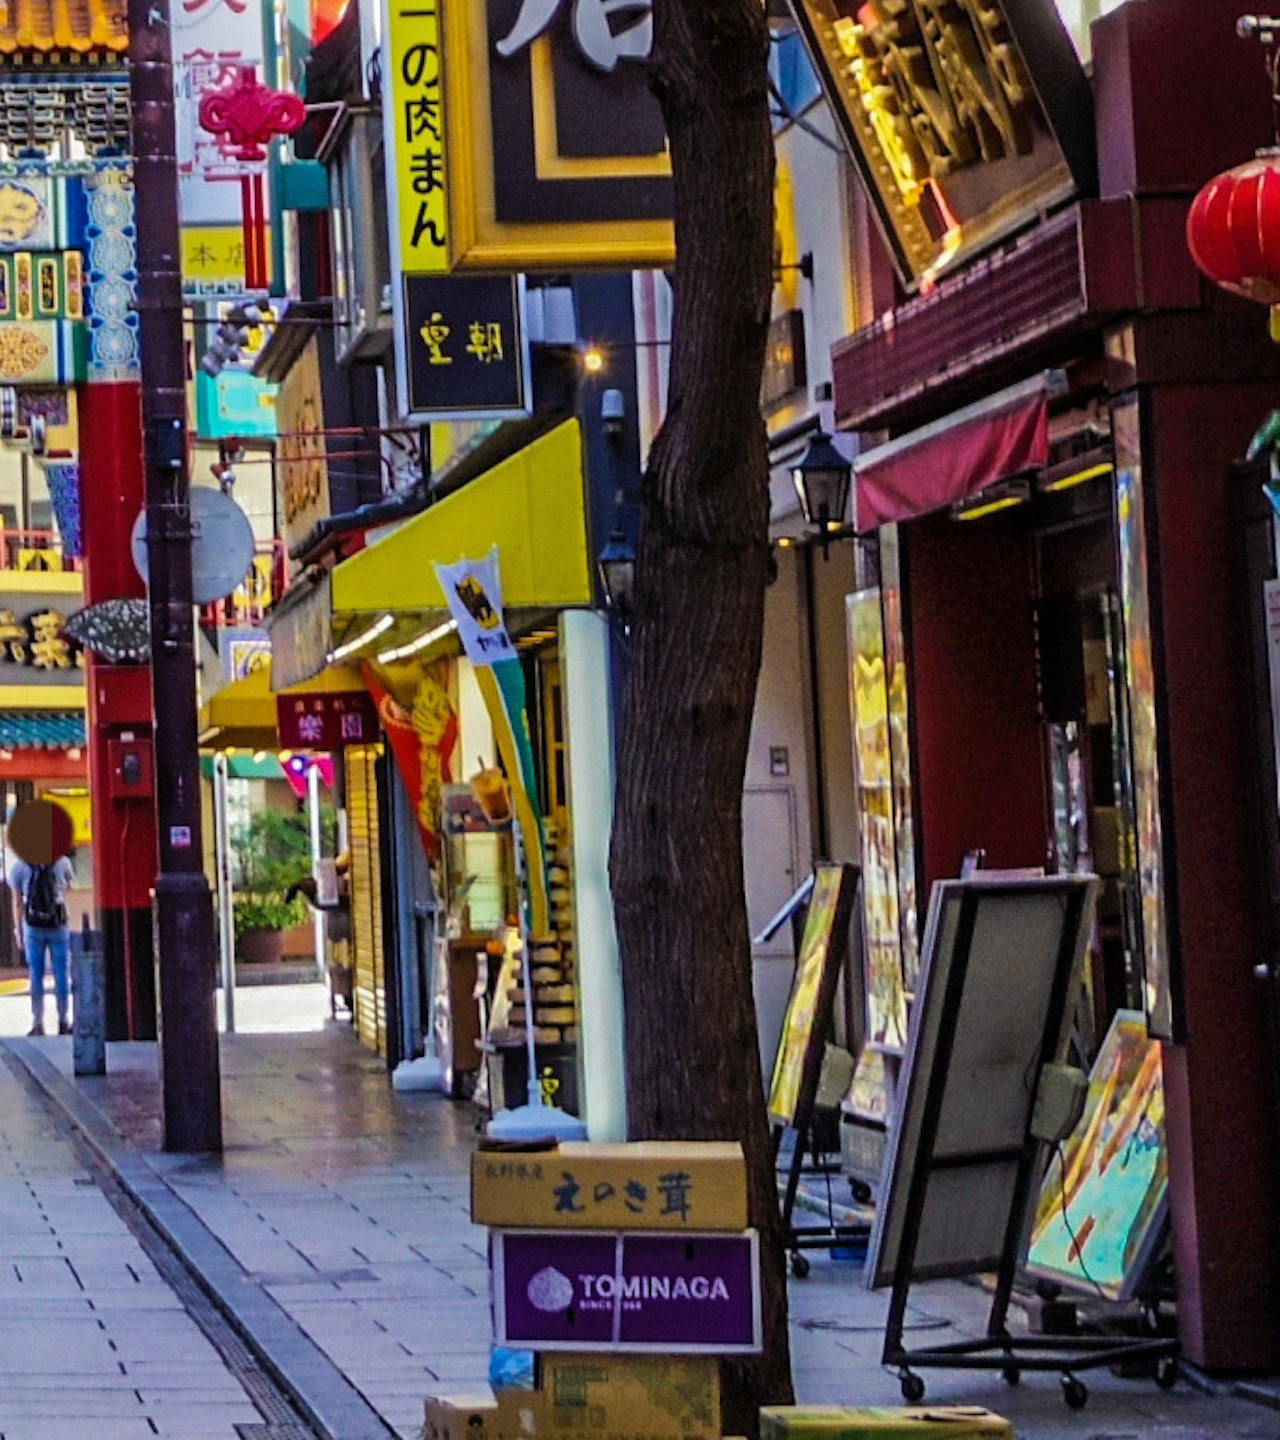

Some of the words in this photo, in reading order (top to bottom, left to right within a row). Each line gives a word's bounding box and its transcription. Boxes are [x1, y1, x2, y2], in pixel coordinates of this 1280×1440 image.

[552, 1170, 694, 1221] えのき茸
[578, 1273, 731, 1301] TOMINAGA
